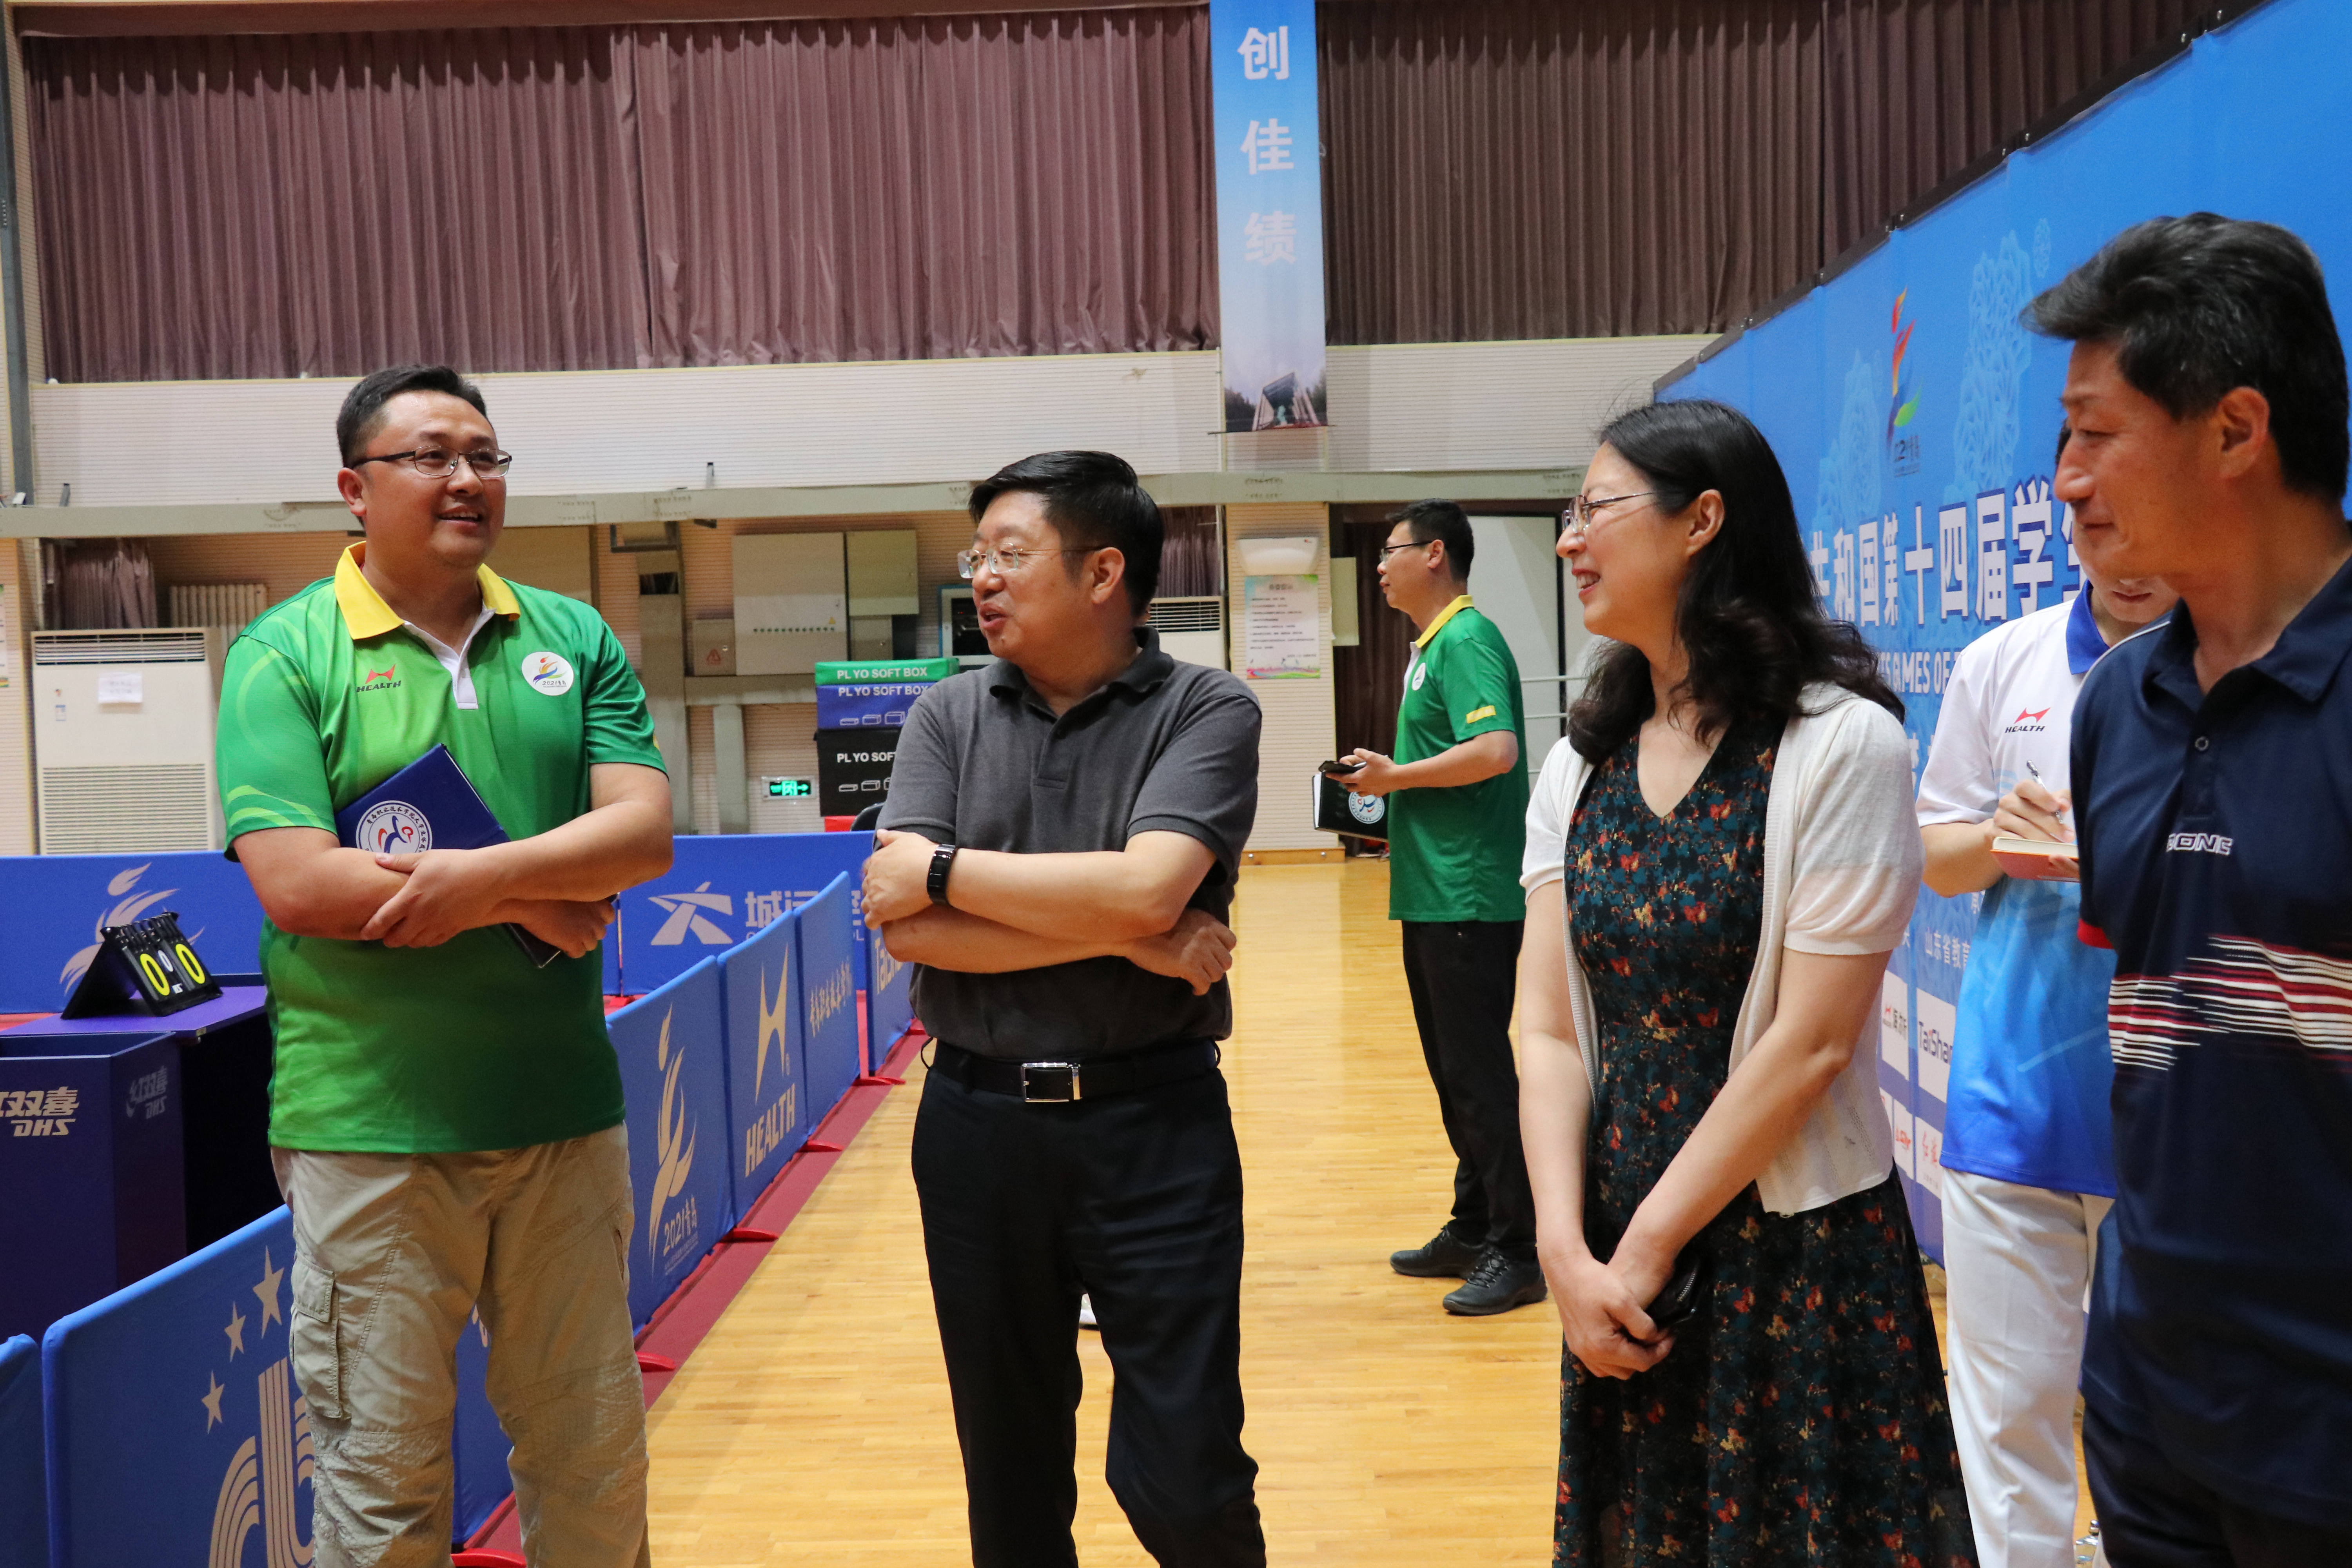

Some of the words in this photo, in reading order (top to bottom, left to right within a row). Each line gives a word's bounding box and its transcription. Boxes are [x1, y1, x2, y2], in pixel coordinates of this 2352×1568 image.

[1237, 25, 1298, 266] 创佳绩
[837, 670, 851, 679] PL
[853, 669, 869, 679] YO
[871, 668, 901, 679] SOFT
[903, 667, 927, 677] BOX
[1934, 651, 1951, 694] OF
[356, 680, 401, 693] HEALTH
[838, 687, 853, 697] PL
[854, 687, 871, 696] YO
[873, 686, 902, 696] SOFT
[2004, 725, 2045, 733] HEALTH
[837, 753, 852, 763] PL
[853, 752, 869, 762] YO
[140, 953, 170, 996] 0
[175, 944, 205, 984] 0
[11, 1118, 76, 1136] DHS
[745, 1083, 795, 1178] HEALTH
